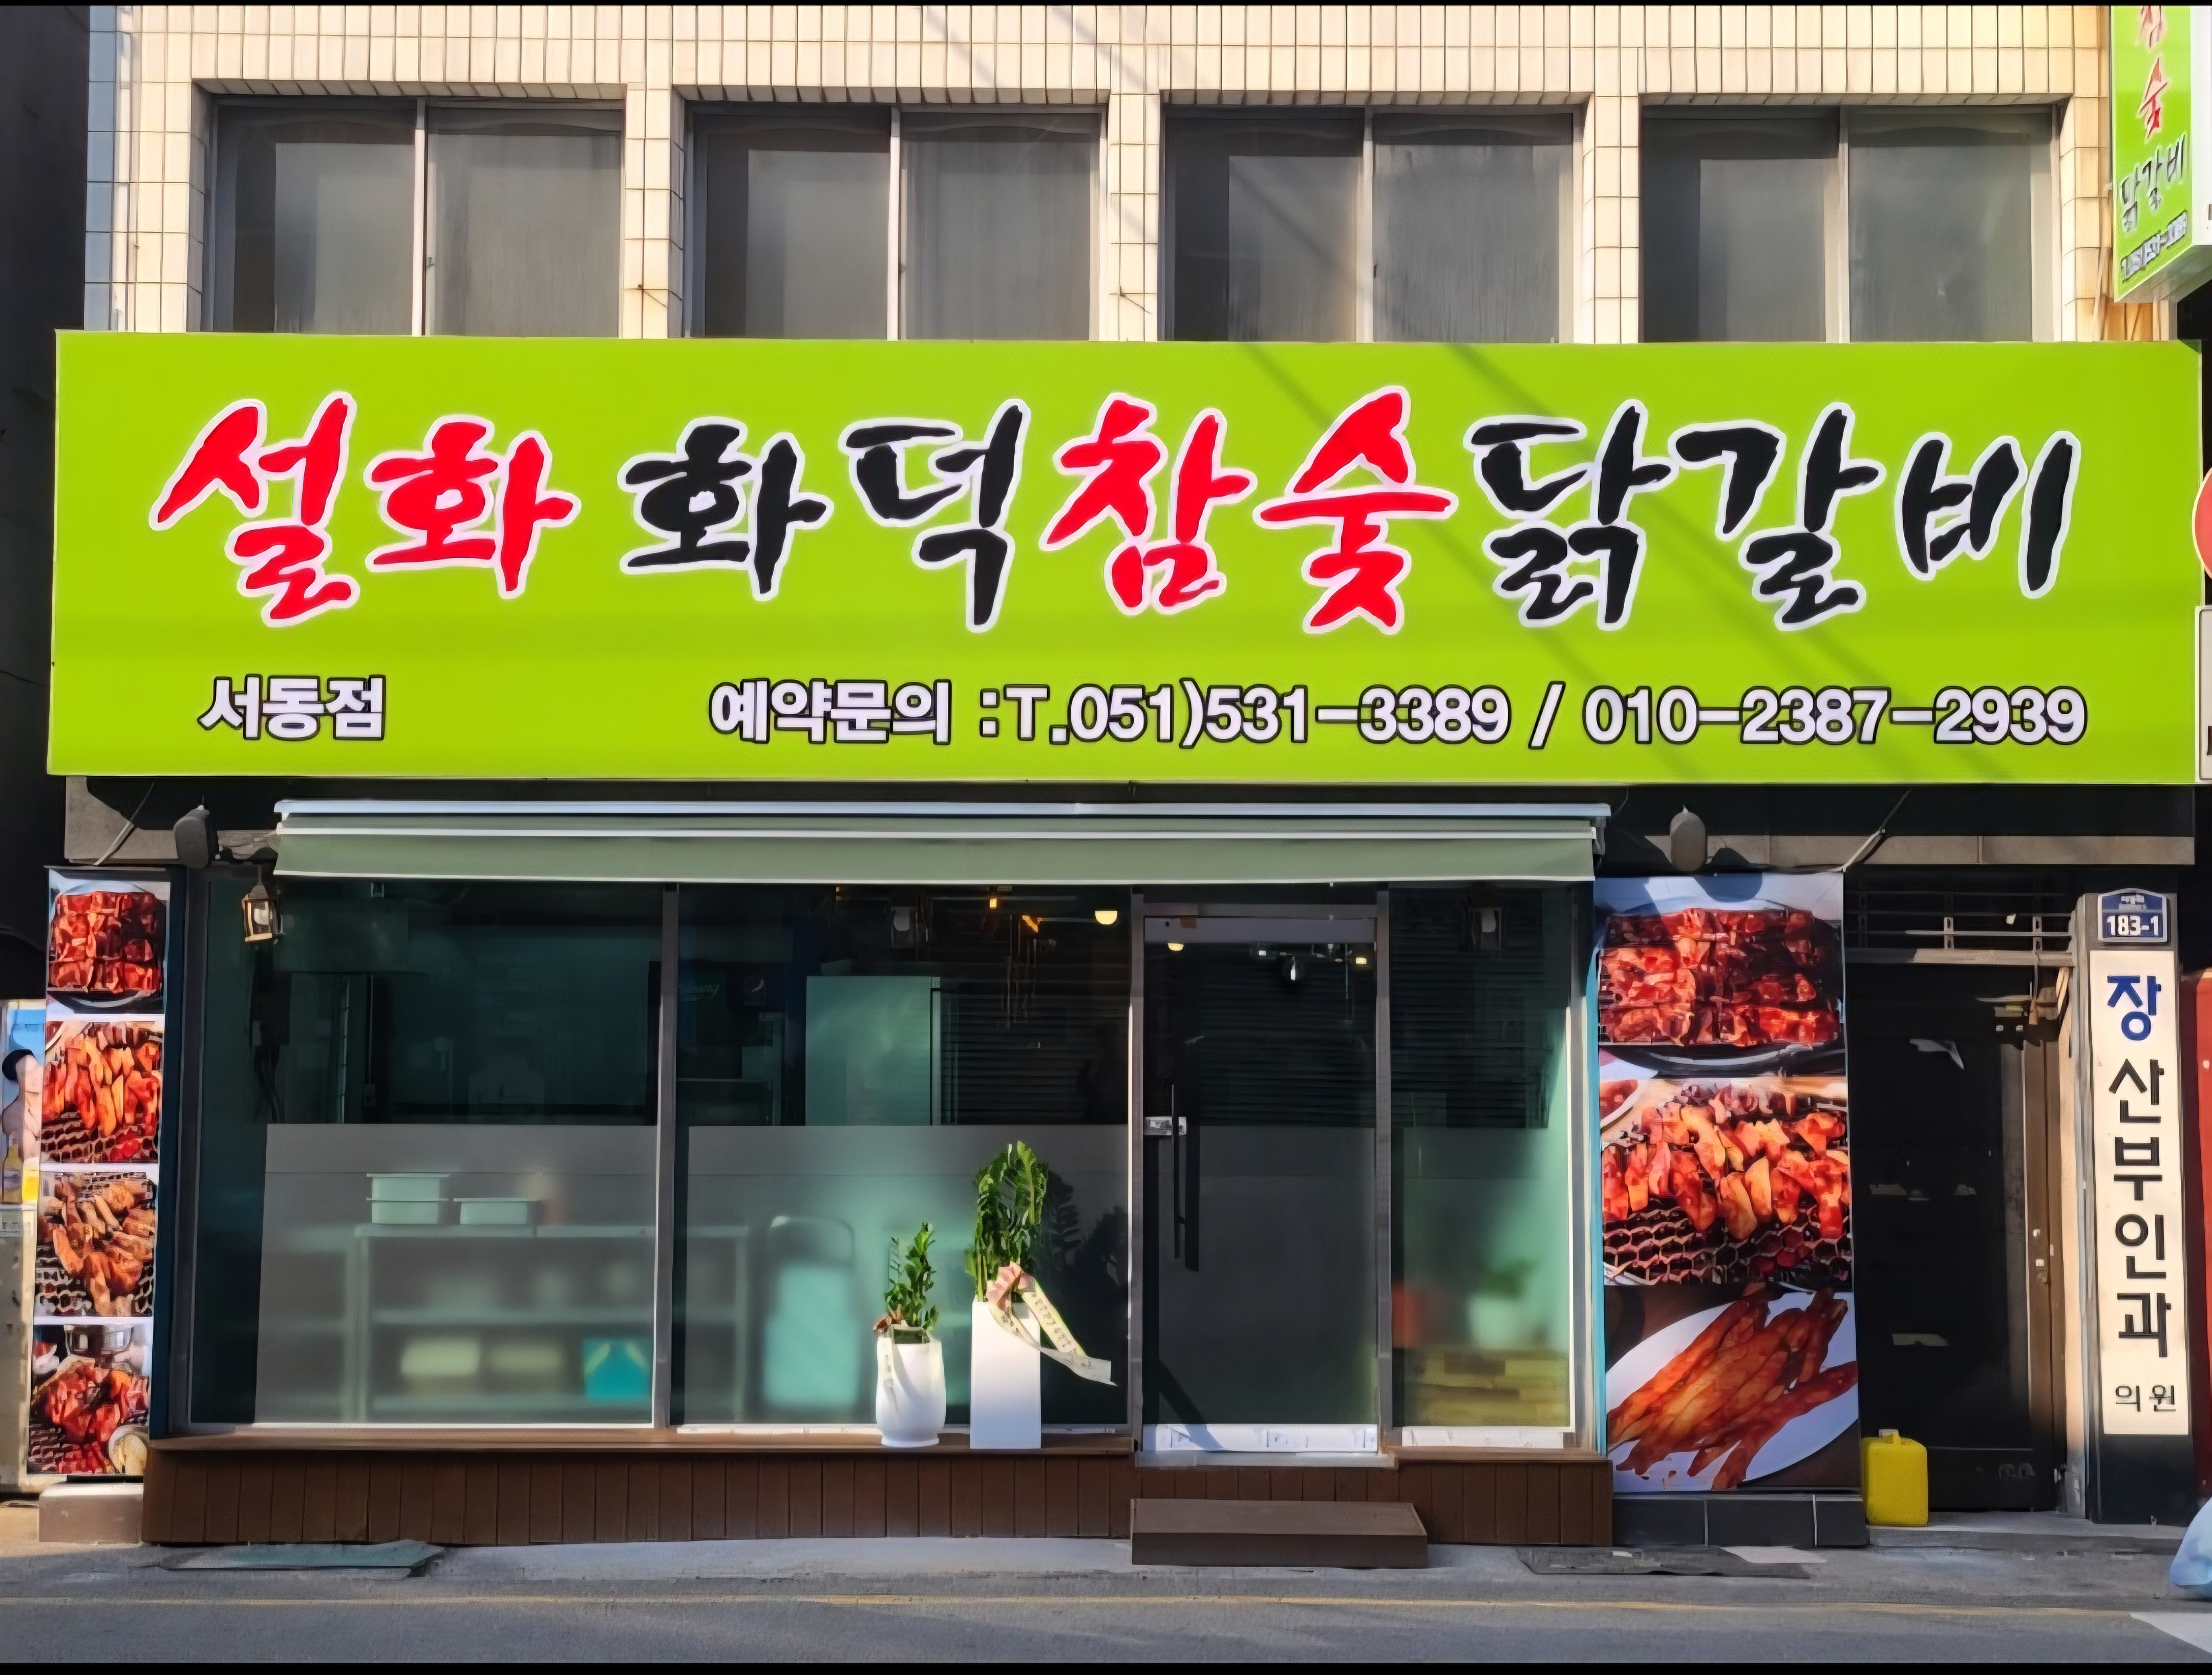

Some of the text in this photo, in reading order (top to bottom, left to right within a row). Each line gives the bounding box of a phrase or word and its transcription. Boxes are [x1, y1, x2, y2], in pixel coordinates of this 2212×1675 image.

[150, 391, 581, 628] 설화
[197, 673, 387, 741] 서동점
[709, 677, 952, 745] 예약문의
[1583, 686, 2088, 745] 010-2387-2939
[2107, 915, 2159, 937] 183-1
[2115, 1384, 2177, 1412] 의원
